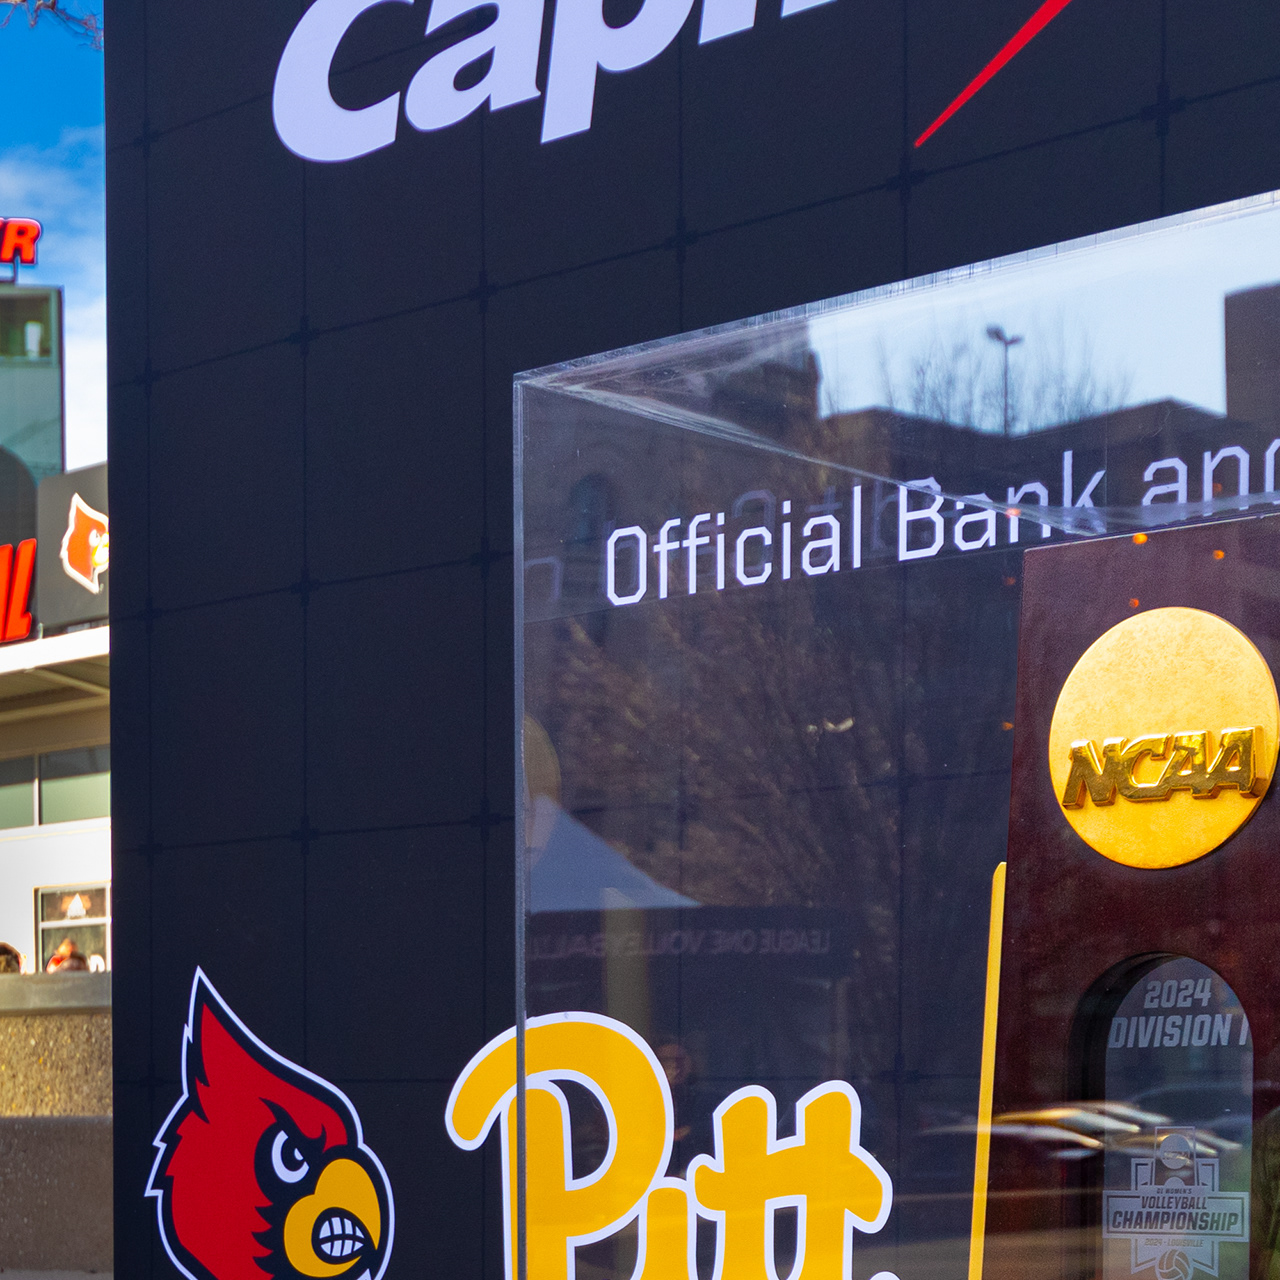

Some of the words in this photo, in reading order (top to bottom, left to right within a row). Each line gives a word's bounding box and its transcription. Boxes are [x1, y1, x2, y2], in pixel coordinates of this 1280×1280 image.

[272, 0, 838, 162] Cap
[606, 485, 862, 607] Official
[898, 449, 1107, 561] Bank
[1062, 726, 1266, 809] NCAA
[1144, 978, 1212, 1008] 2024
[1109, 1013, 1232, 1048] DIVISION
[1112, 1210, 1239, 1231] CHAMPIONSHIP
[1141, 1196, 1207, 1210] VOLLEYBALL
